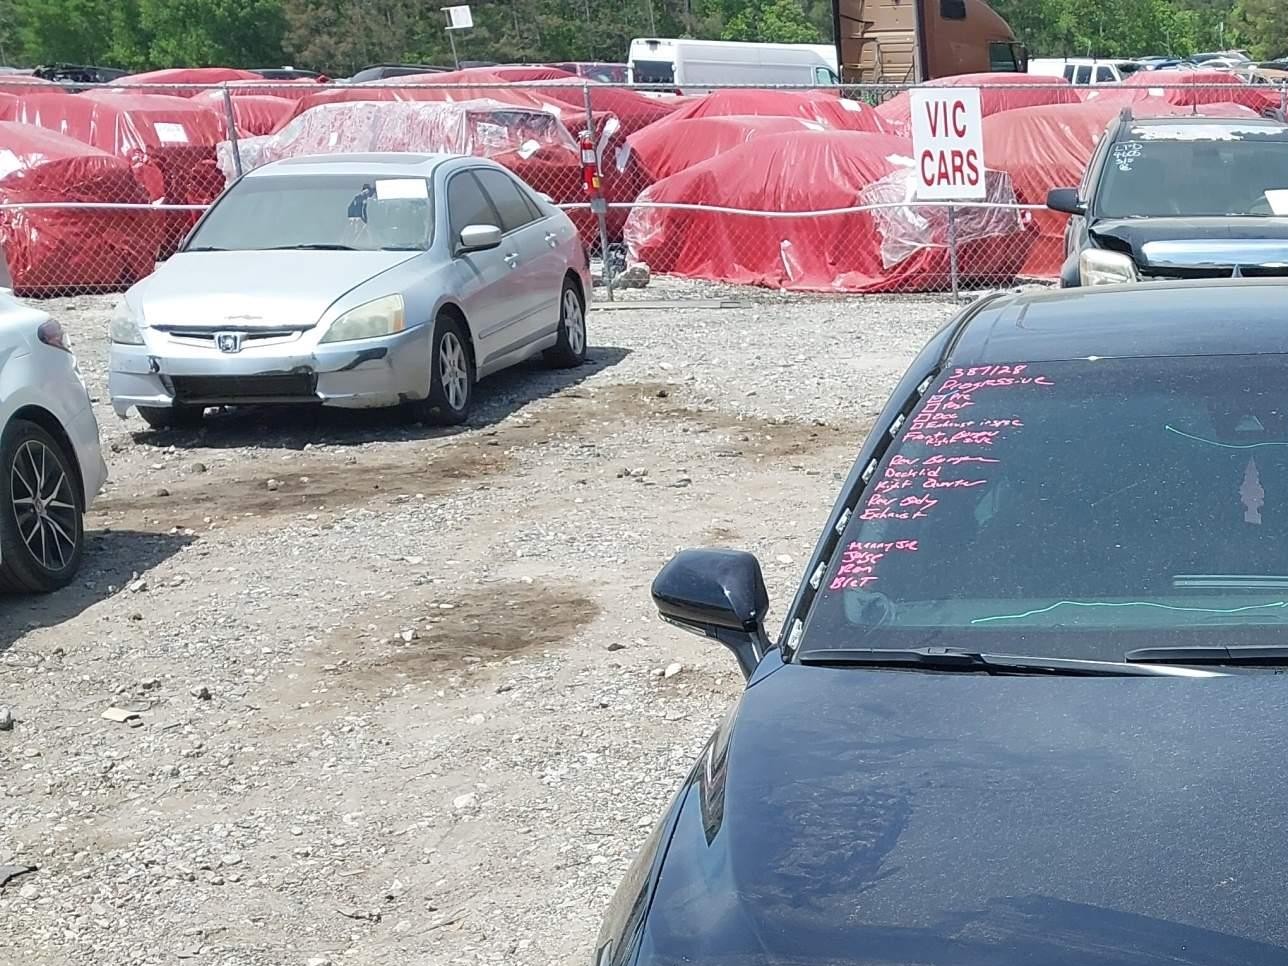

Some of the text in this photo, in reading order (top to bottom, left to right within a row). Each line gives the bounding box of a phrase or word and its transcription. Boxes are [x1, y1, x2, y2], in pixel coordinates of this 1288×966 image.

[924, 100, 967, 139] VIC
[920, 149, 980, 187] CARS
[949, 364, 1028, 379] 387128
